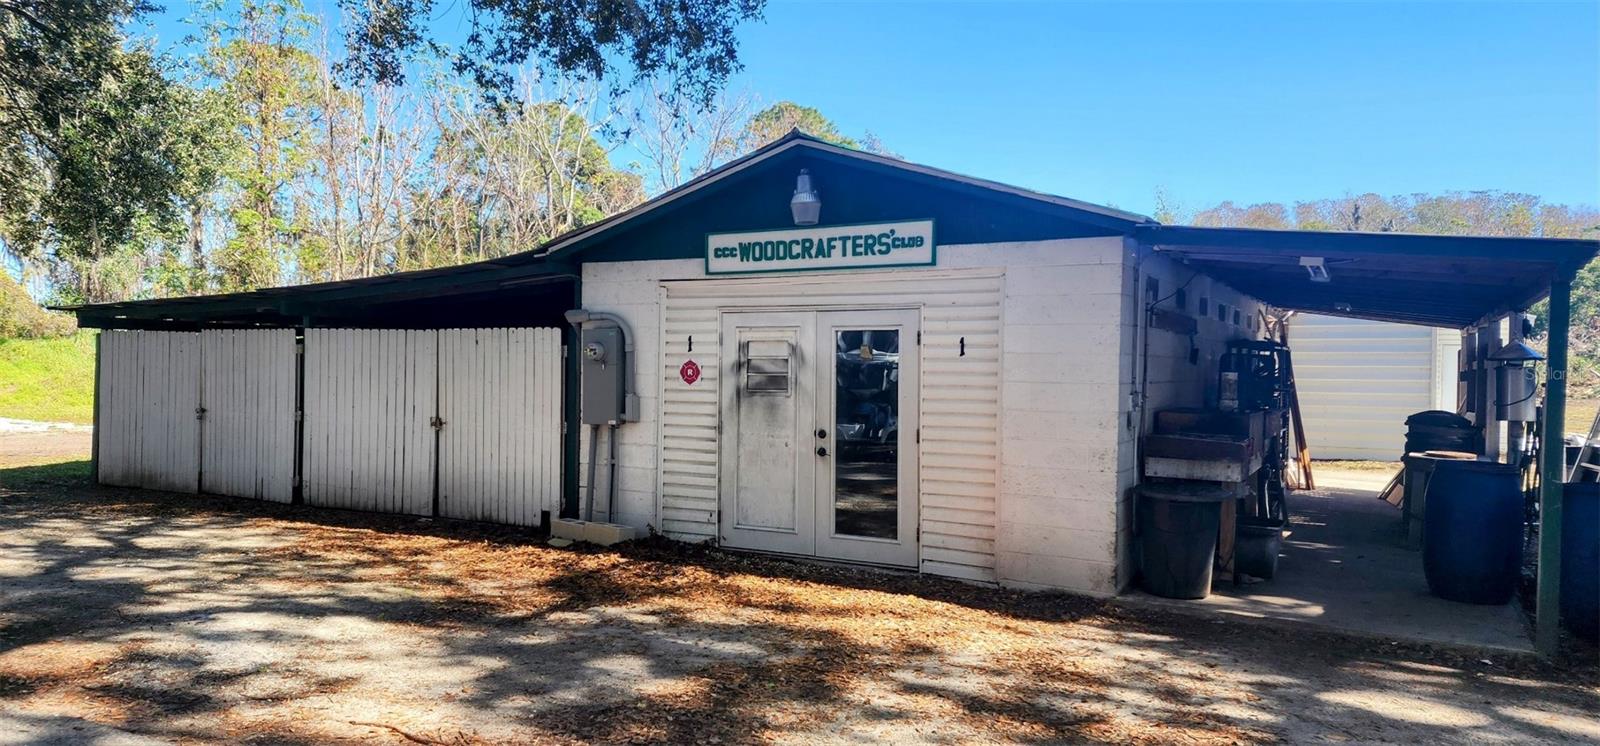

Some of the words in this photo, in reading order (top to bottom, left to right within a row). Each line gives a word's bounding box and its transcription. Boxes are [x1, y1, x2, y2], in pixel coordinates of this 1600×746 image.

[892, 235, 924, 249] CLUB
[688, 336, 692, 352] 1
[960, 337, 965, 356] 1
[687, 368, 693, 376] R
